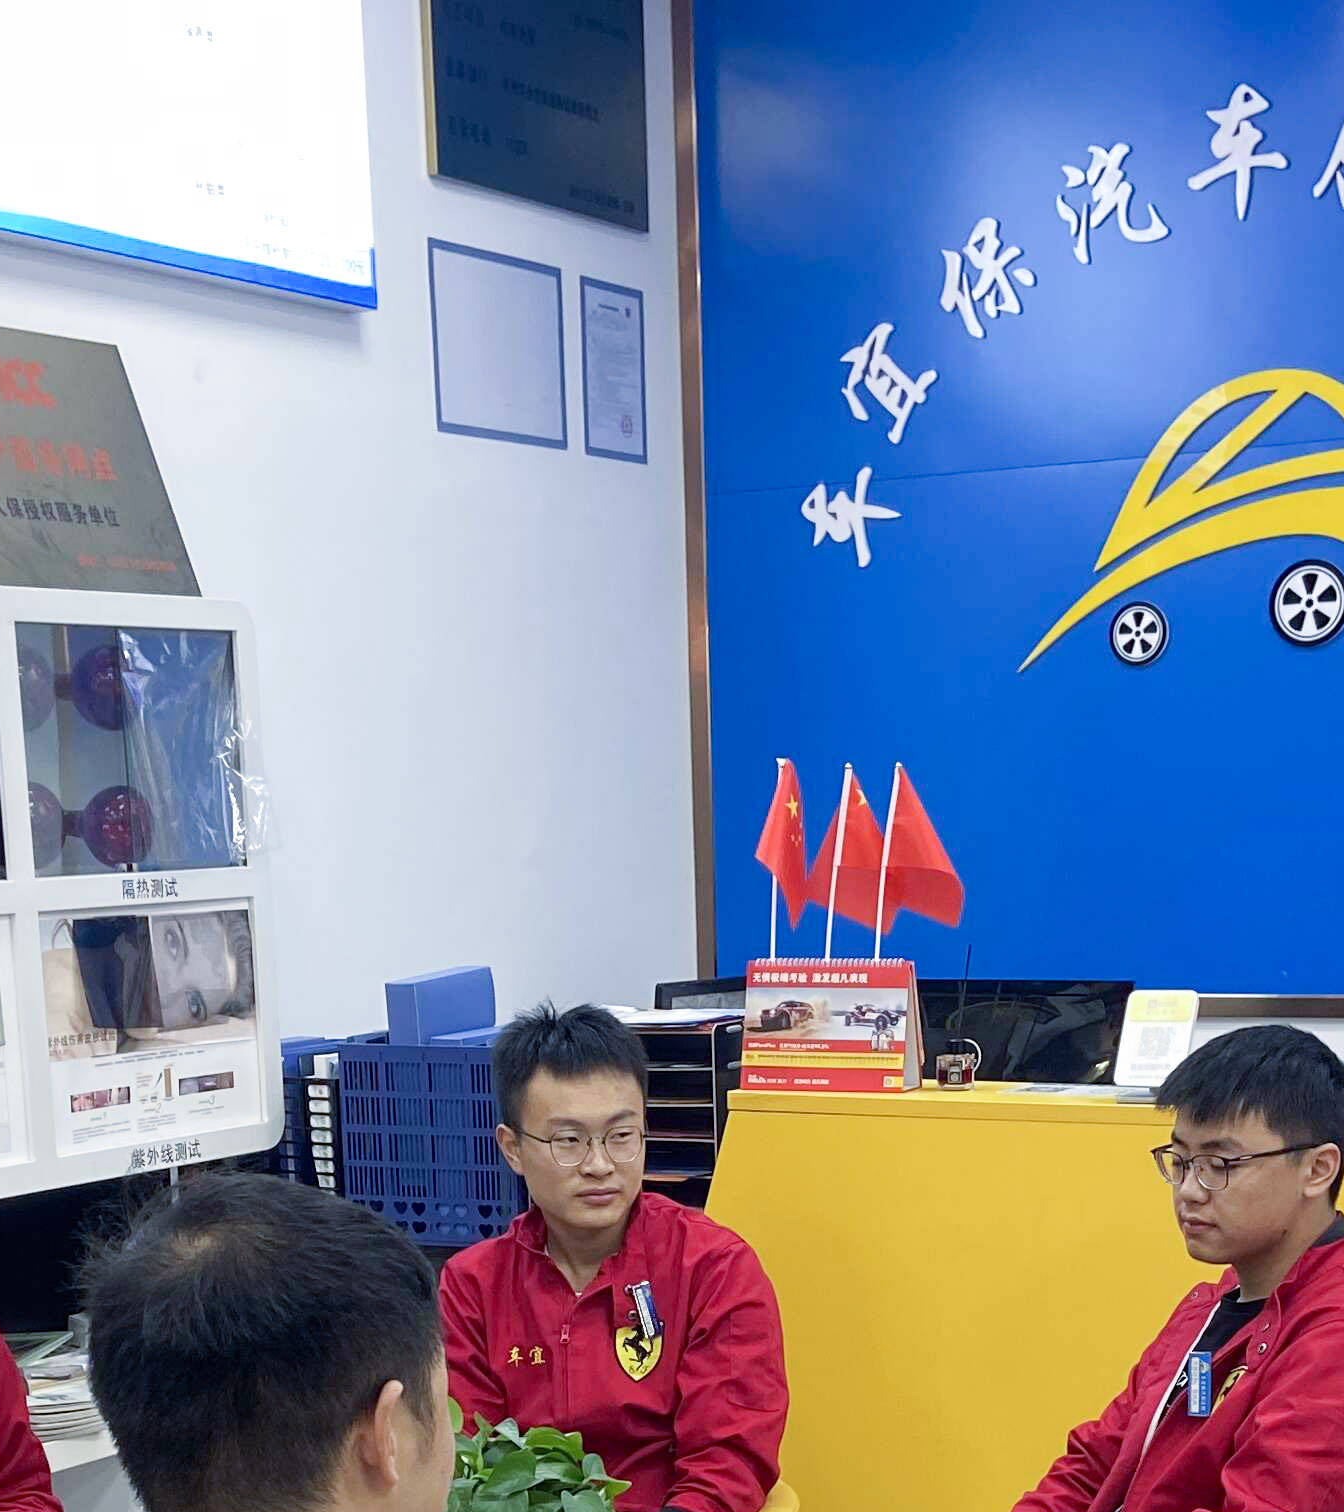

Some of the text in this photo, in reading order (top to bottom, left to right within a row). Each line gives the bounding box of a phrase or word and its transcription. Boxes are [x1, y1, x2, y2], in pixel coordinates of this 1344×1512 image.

[121, 878, 179, 900] 隔热测试
[131, 1137, 202, 1169] 紫外线测试
[506, 1345, 547, 1369] 车宜
